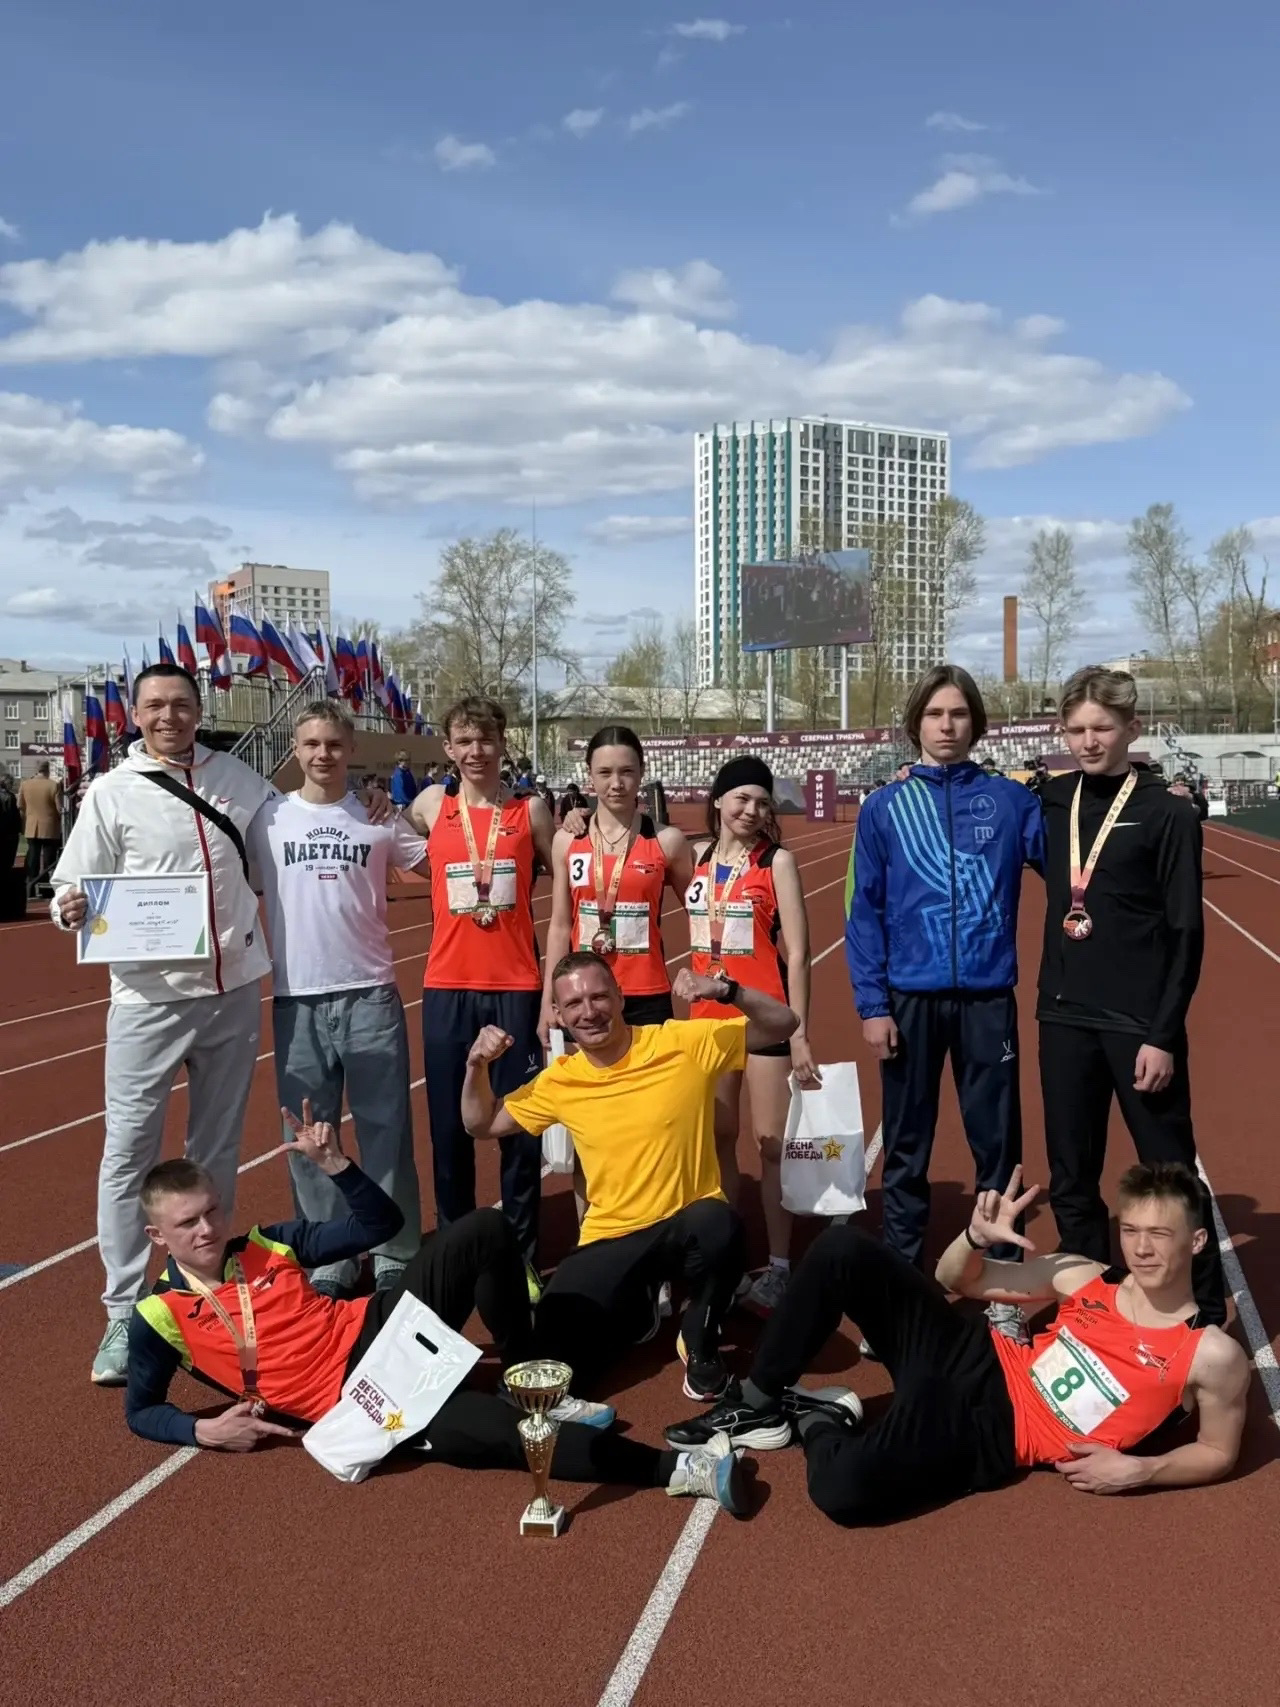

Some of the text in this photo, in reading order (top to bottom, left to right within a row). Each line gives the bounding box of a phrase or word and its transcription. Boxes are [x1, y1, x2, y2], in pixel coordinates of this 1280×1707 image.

[800, 732, 865, 742] СЕВЕРНАЯ ТРИБУНА
[1002, 724, 1051, 734] ЕКАТЕРИНБУРГ
[640, 739, 687, 747] КАТЕРИНБУРГ
[814, 774, 824, 818] ФИНИШ
[305, 826, 351, 842] HOLIDAY
[283, 841, 372, 868] NAETALIY
[572, 858, 584, 881] 3
[688, 881, 703, 903] 3
[357, 1377, 385, 1409] ВЕСНА
[1050, 1366, 1086, 1402] 8
[349, 1387, 386, 1426] ПОБЕДЫ
